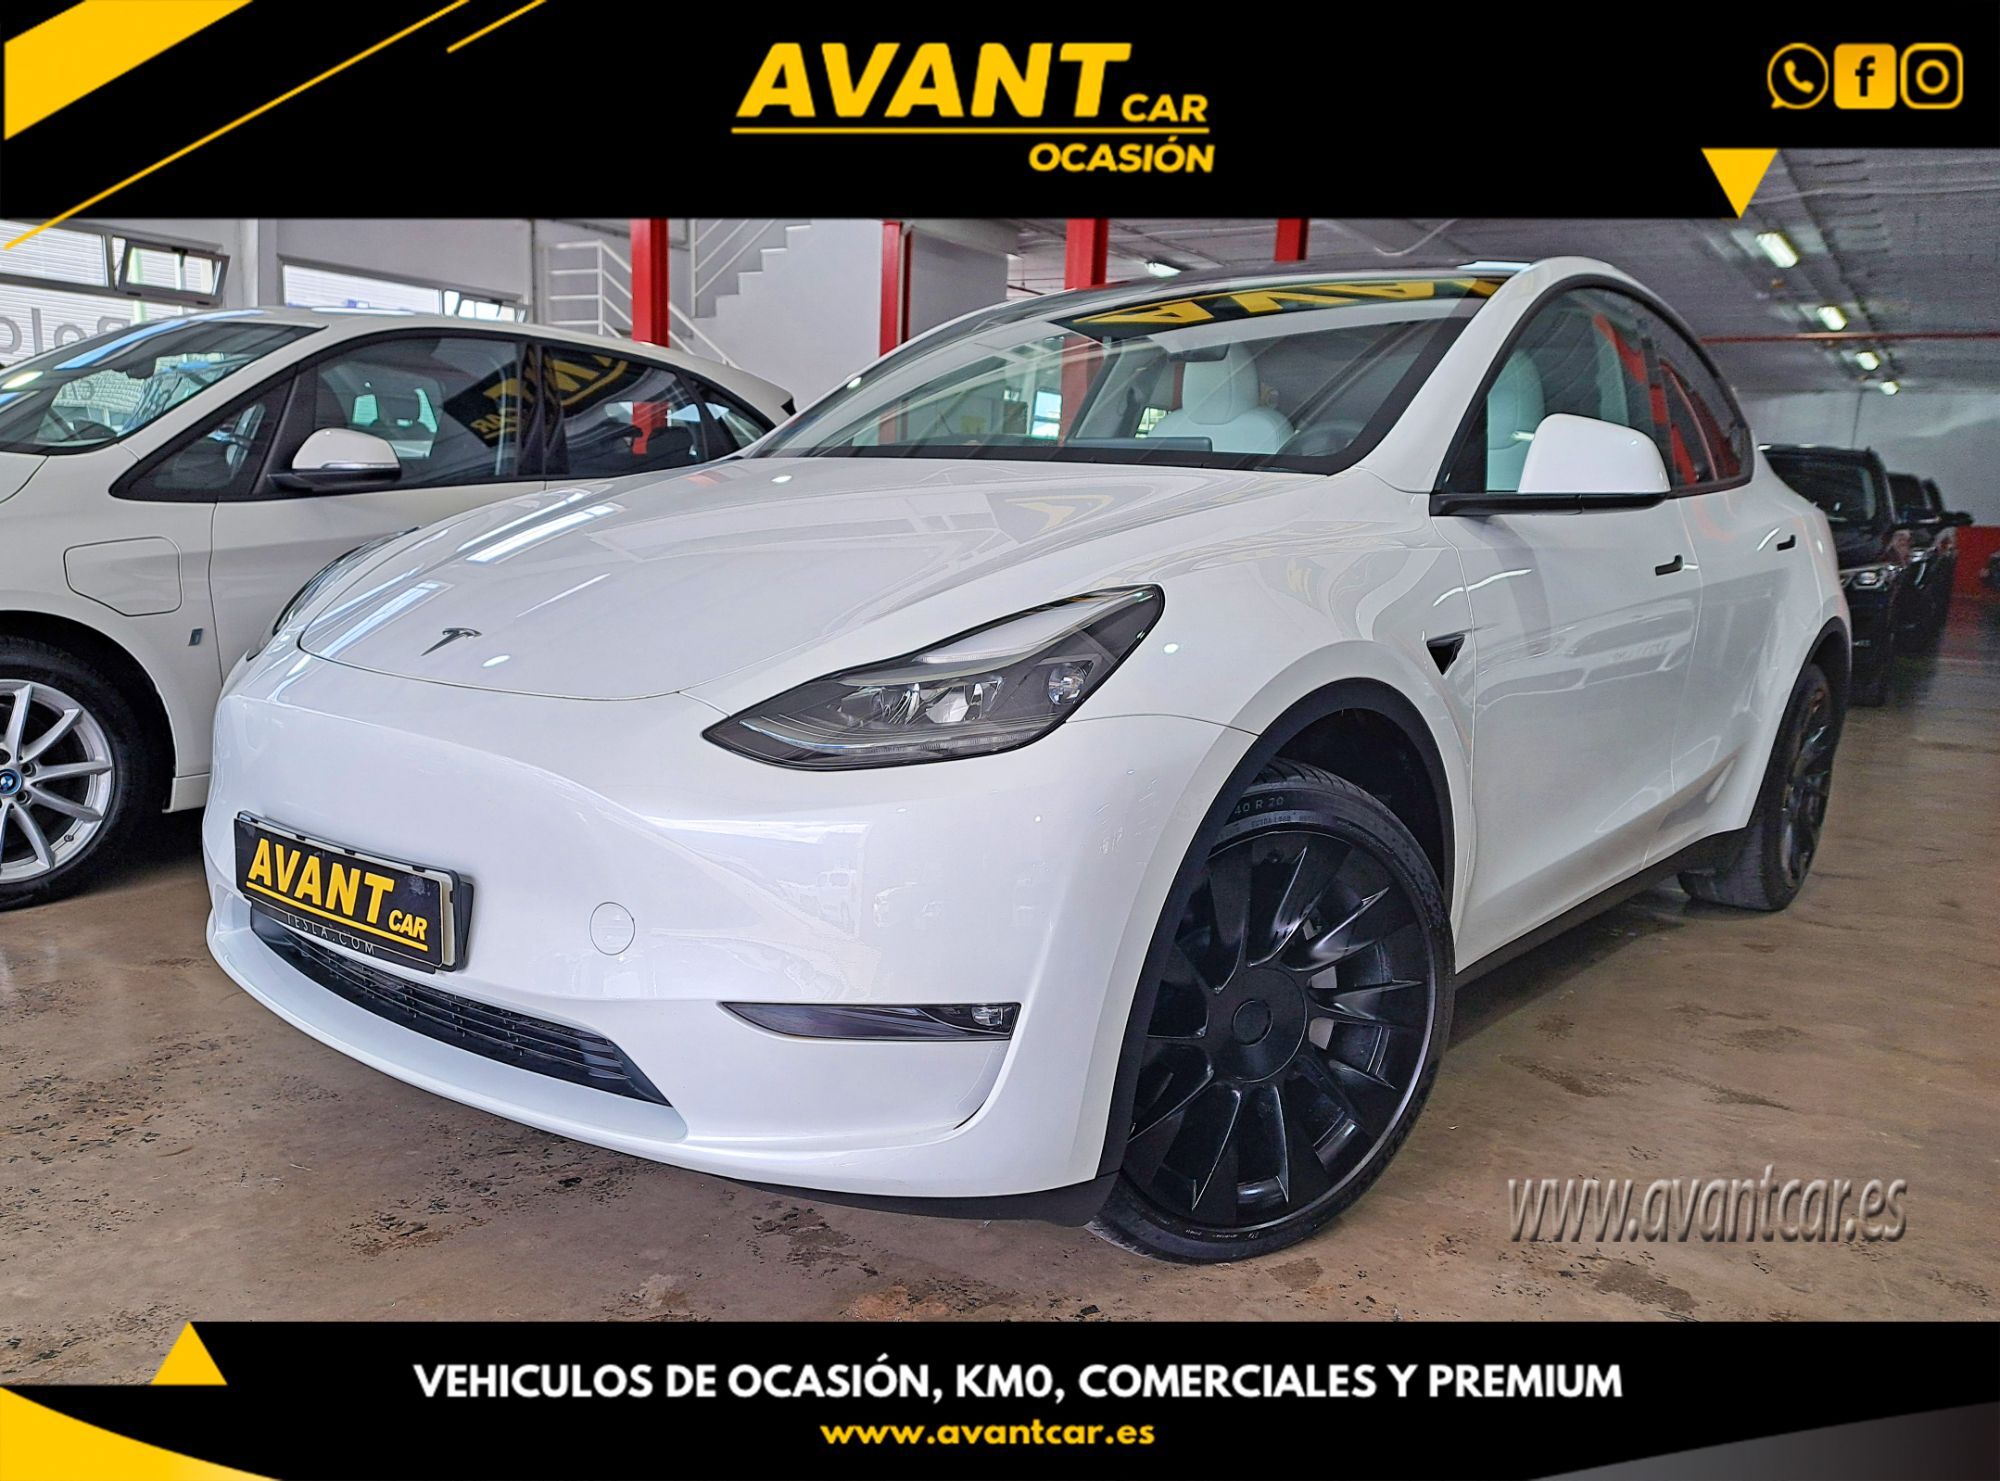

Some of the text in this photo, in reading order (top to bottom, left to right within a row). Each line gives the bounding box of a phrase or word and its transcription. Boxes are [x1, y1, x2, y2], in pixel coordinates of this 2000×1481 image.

[1255, 799, 1263, 810] R
[247, 837, 428, 941] AVANT CAR
[286, 912, 376, 956] TESLA.COM
